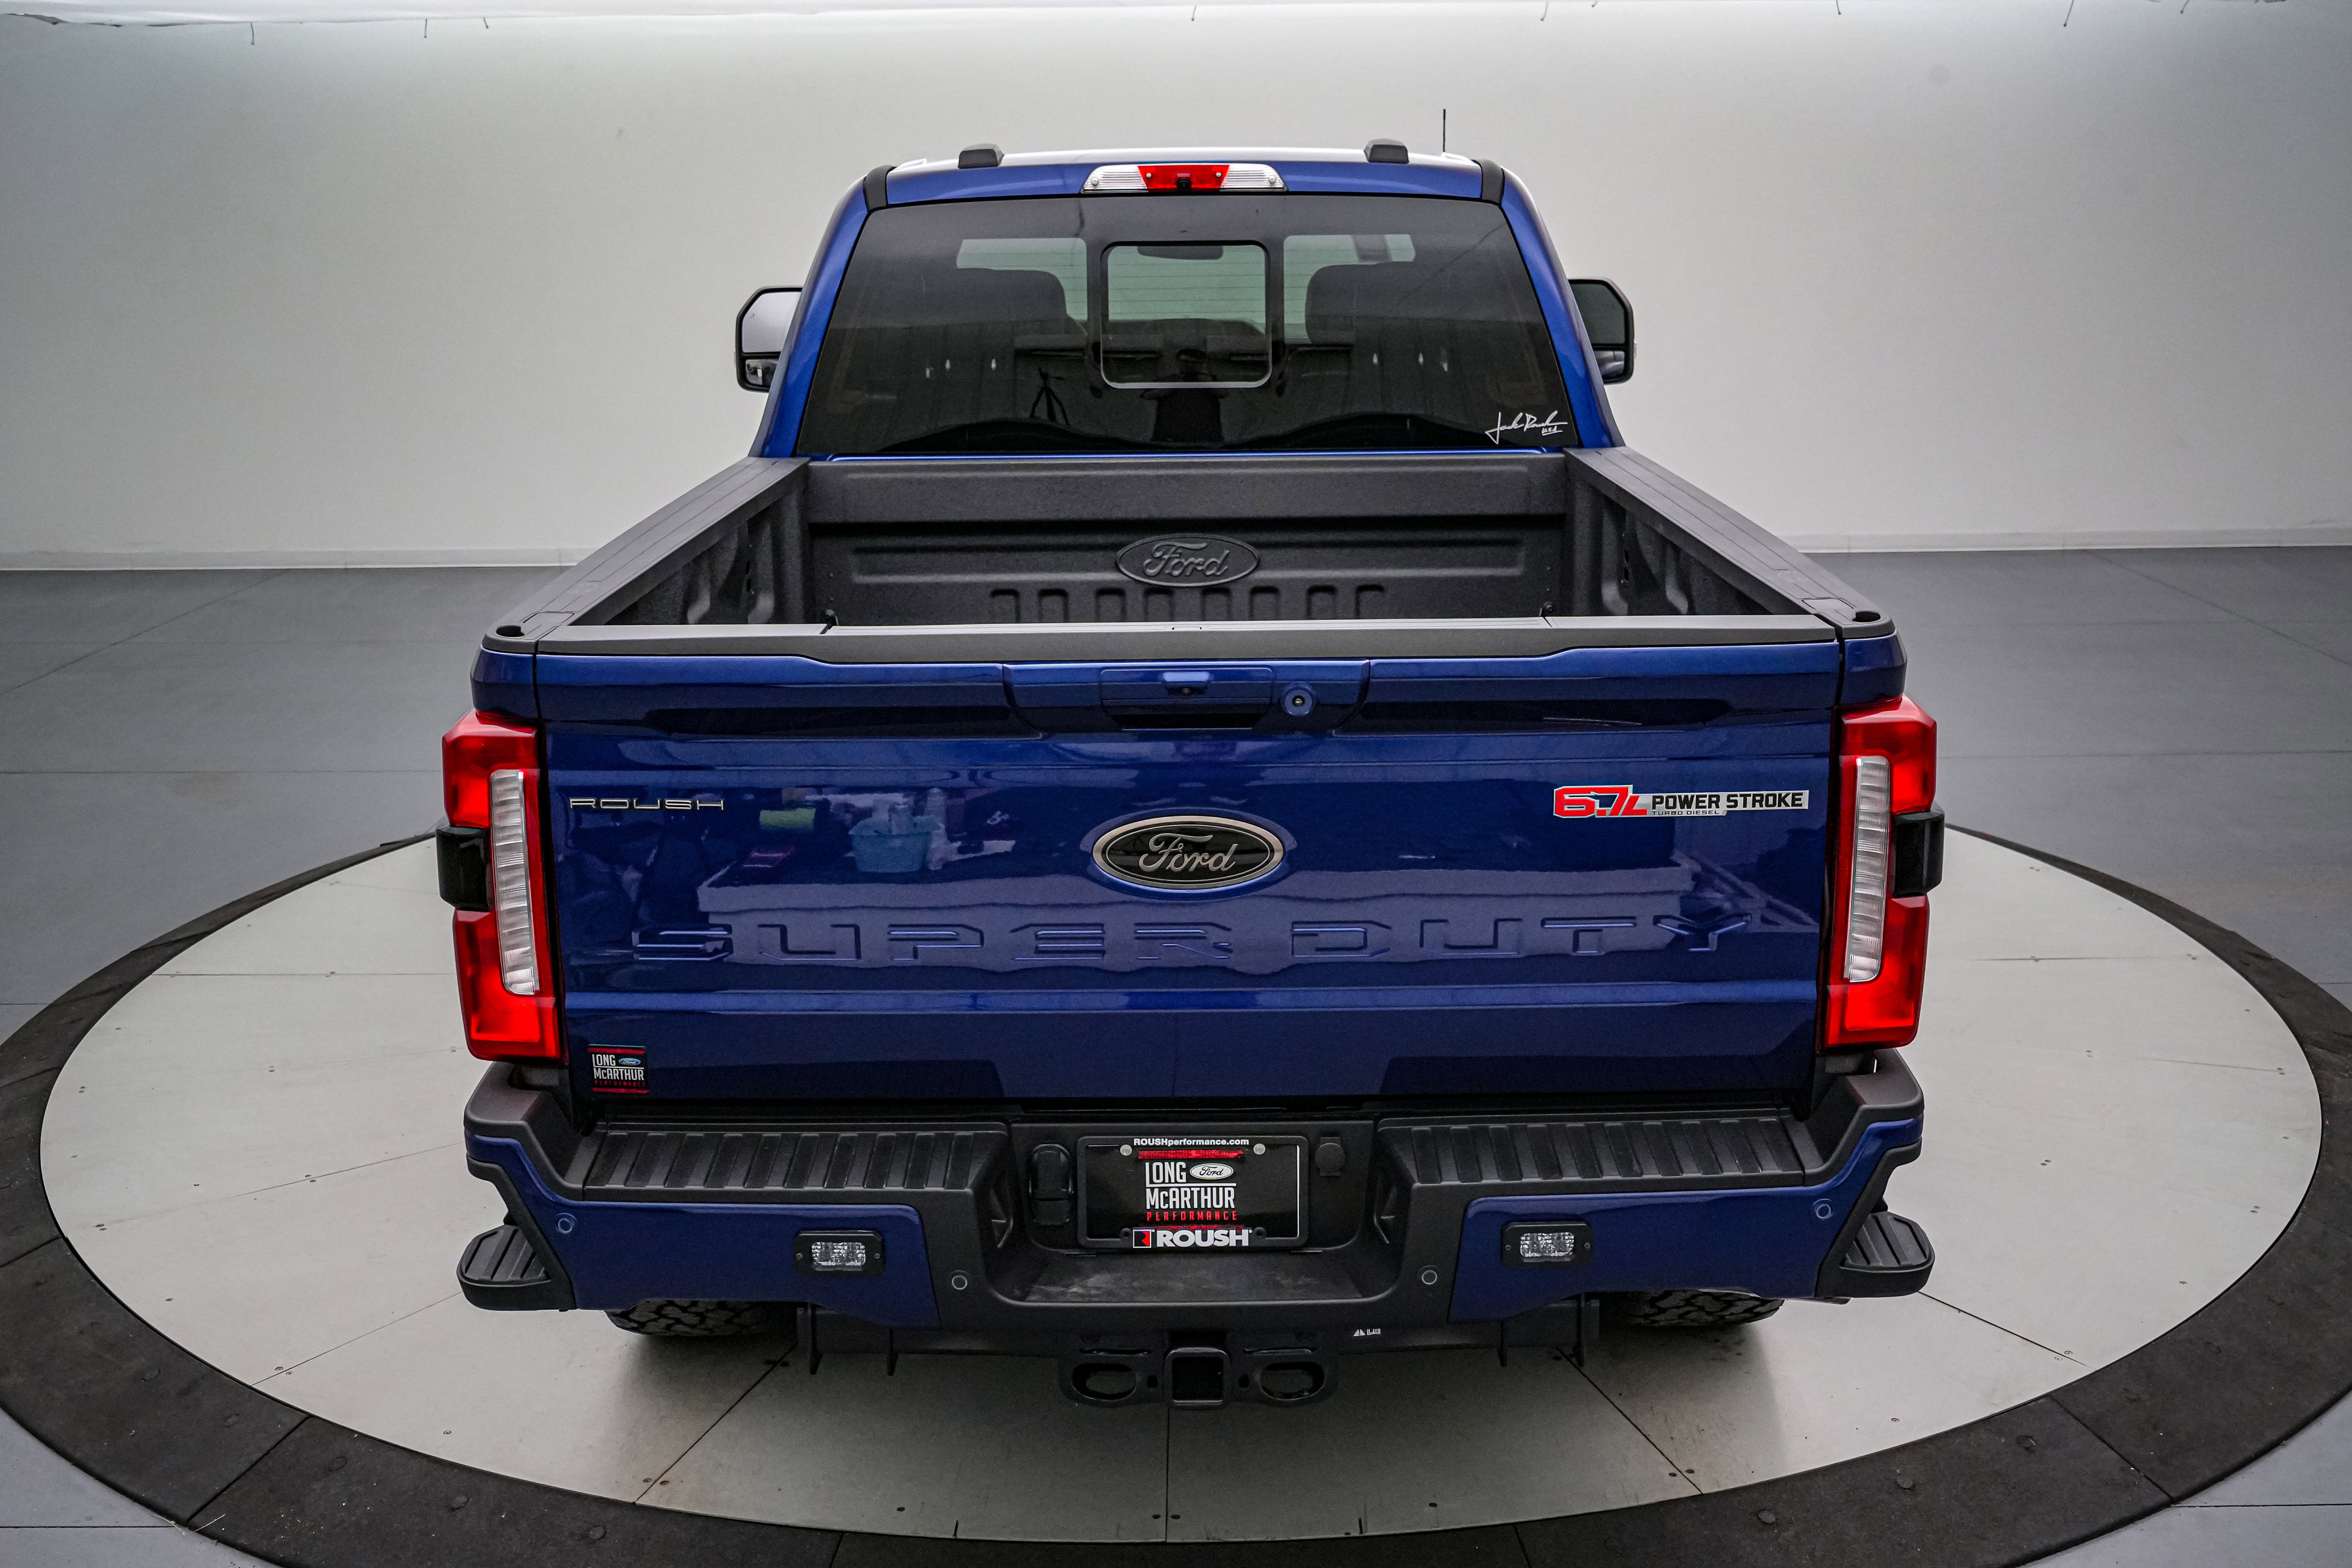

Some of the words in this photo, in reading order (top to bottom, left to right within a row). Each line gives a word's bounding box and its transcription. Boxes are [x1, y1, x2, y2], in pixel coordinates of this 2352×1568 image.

[1143, 541, 1230, 577] Ford
[569, 797, 724, 811] ROUSH
[1554, 785, 1648, 817] 6.7L
[1652, 794, 1720, 809] POWER
[1726, 792, 1803, 808] STROKE
[1138, 833, 1238, 872] Ford
[631, 922, 1233, 960] SUPER
[1291, 913, 1752, 958] DUTY
[592, 1054, 616, 1067] LONG
[593, 1068, 644, 1080] McARTHUR
[1134, 1138, 1249, 1147] ROUSHperformance.com
[1145, 1162, 1187, 1185] LONG
[1199, 1166, 1224, 1177] Ford
[1146, 1187, 1235, 1209] McARTHUR
[1146, 1211, 1238, 1222] PERFORMANCE
